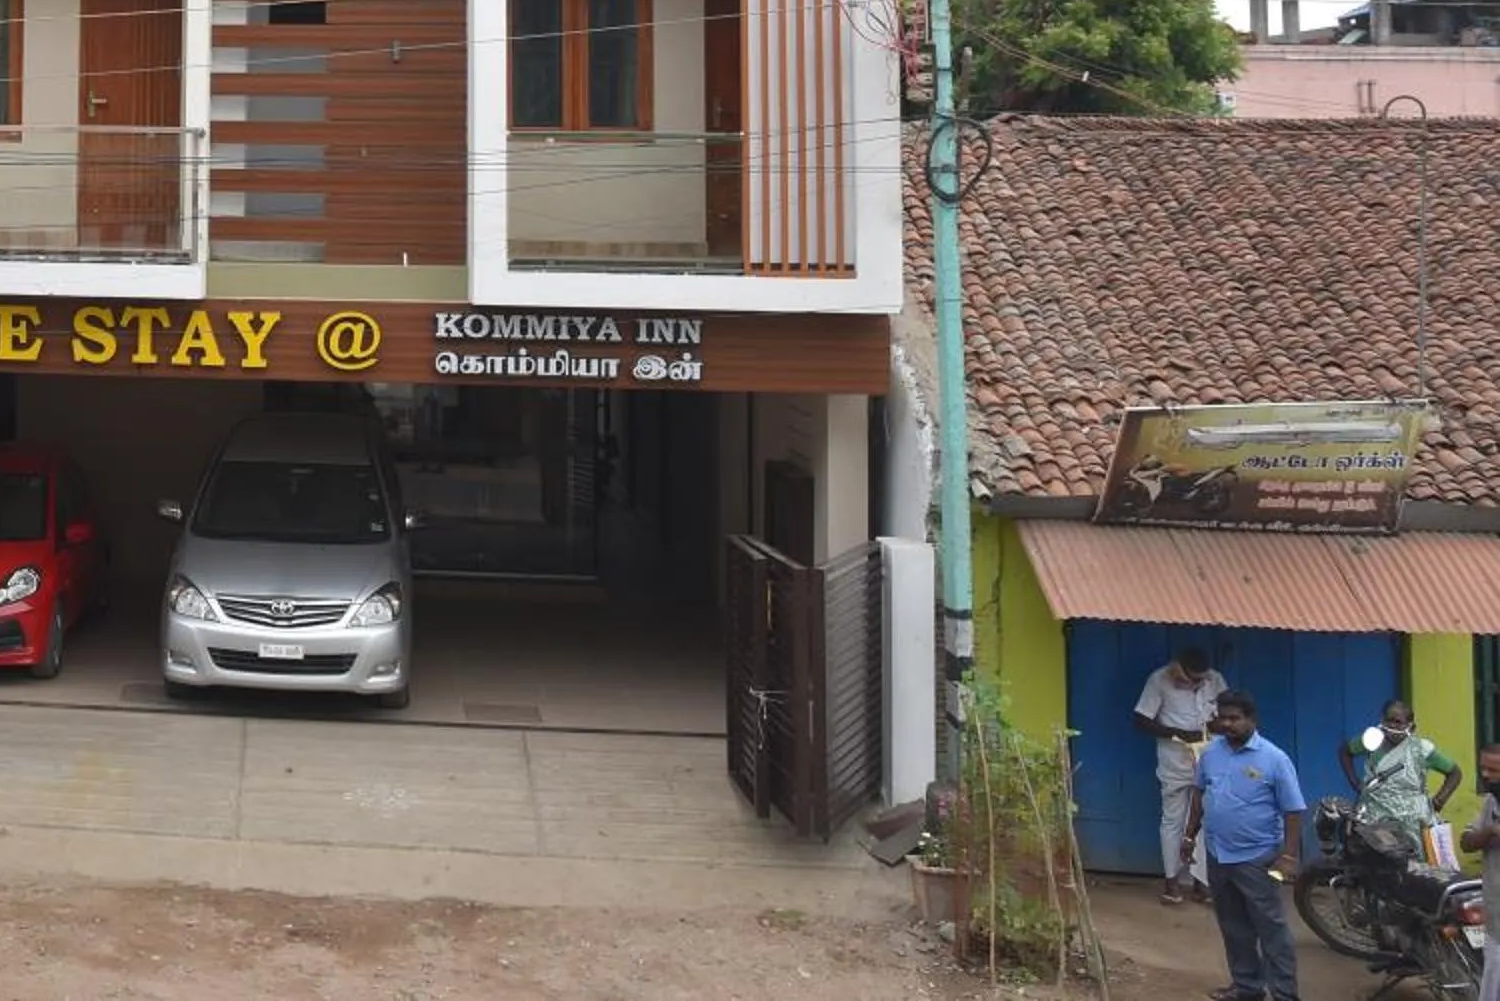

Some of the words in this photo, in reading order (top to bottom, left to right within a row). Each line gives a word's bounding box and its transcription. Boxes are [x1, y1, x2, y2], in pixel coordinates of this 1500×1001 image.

[70, 305, 282, 369] STAY
[316, 310, 382, 371] @
[434, 312, 623, 343] KOMMIYA
[635, 317, 702, 345] INN
[434, 347, 621, 378] கொம்மியா
[632, 351, 704, 381] இன்
